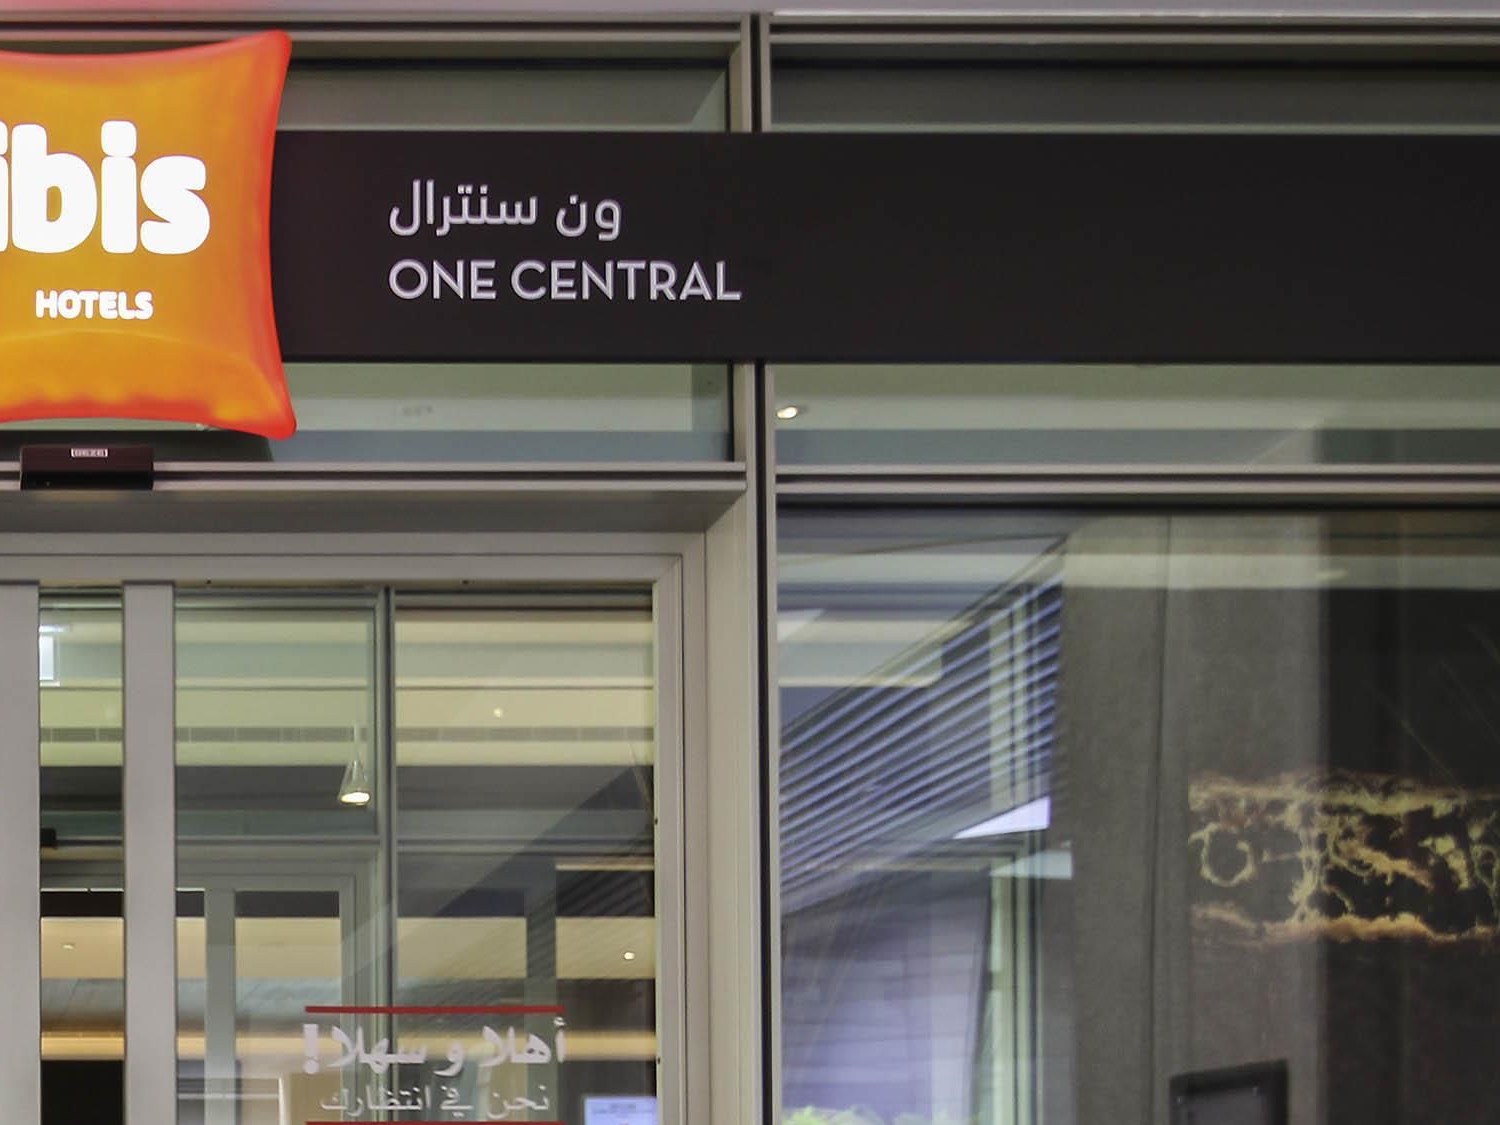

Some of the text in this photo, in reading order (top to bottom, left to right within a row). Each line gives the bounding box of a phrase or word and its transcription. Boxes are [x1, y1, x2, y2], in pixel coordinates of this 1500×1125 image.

[388, 178, 622, 242] ون سنترال
[388, 257, 743, 302] ONE CENTRAL
[34, 289, 155, 320] HOTELS
[433, 1041, 465, 1077] و
[440, 1085, 474, 1118] في
[486, 1084, 550, 1119] نحن
